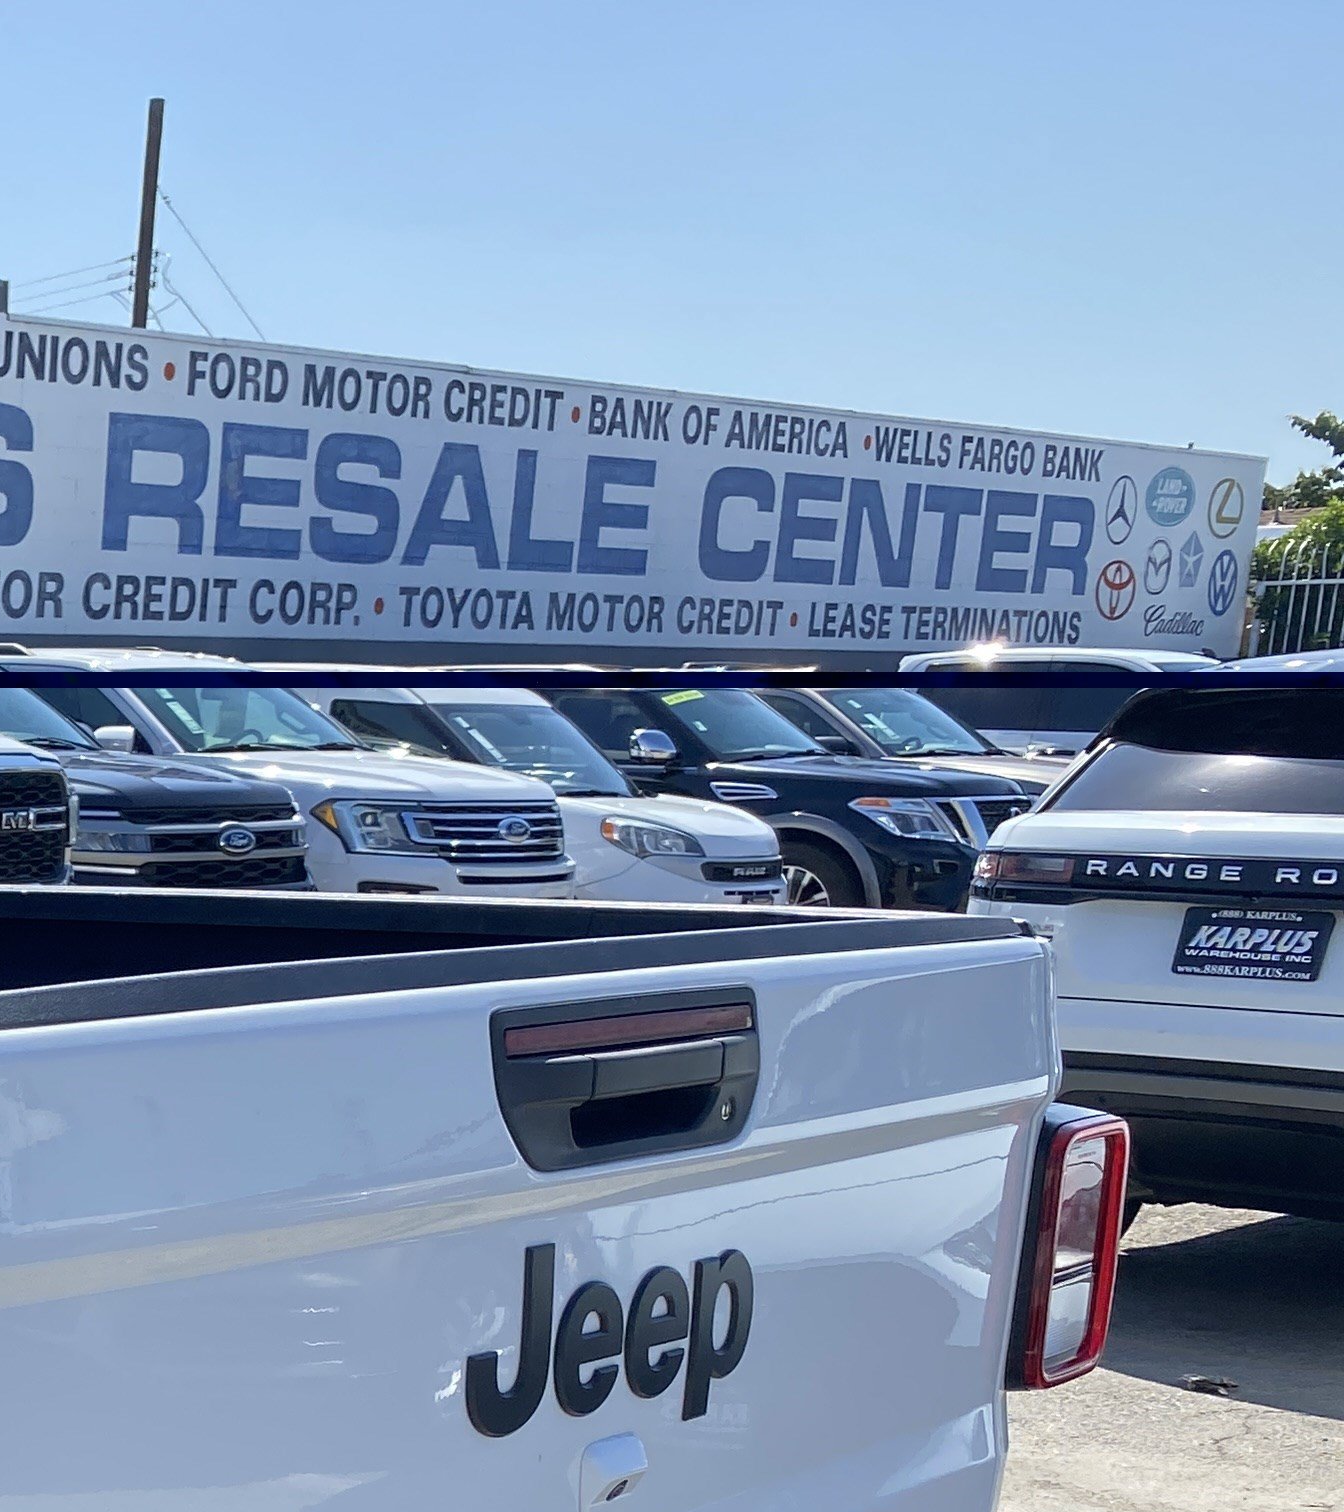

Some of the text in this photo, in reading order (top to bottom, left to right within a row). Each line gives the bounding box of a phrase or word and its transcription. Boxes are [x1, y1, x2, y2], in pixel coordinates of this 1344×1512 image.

[187, 350, 563, 432] FORD MOTOR CREDIT
[589, 395, 849, 459] BANK OF AMERICA
[874, 427, 1105, 483] WELLS FARGO BANK
[101, 411, 657, 578] RESALE
[698, 466, 1096, 597] CENTER
[82, 572, 246, 623] CREDIT
[249, 579, 361, 627] CORP.
[399, 585, 783, 638] TOYOTA MOTOR CREDIT
[808, 601, 1082, 646] LEASE TERMINATIONS
[1143, 604, 1203, 637] Cadillac
[1086, 859, 1337, 884] RANGE RO
[1188, 925, 1319, 954] KARPLUS
[1246, 910, 1298, 921] KARPLUS
[1184, 949, 1312, 963] WAREHOUSE INC
[465, 1242, 754, 1438] Jeep
